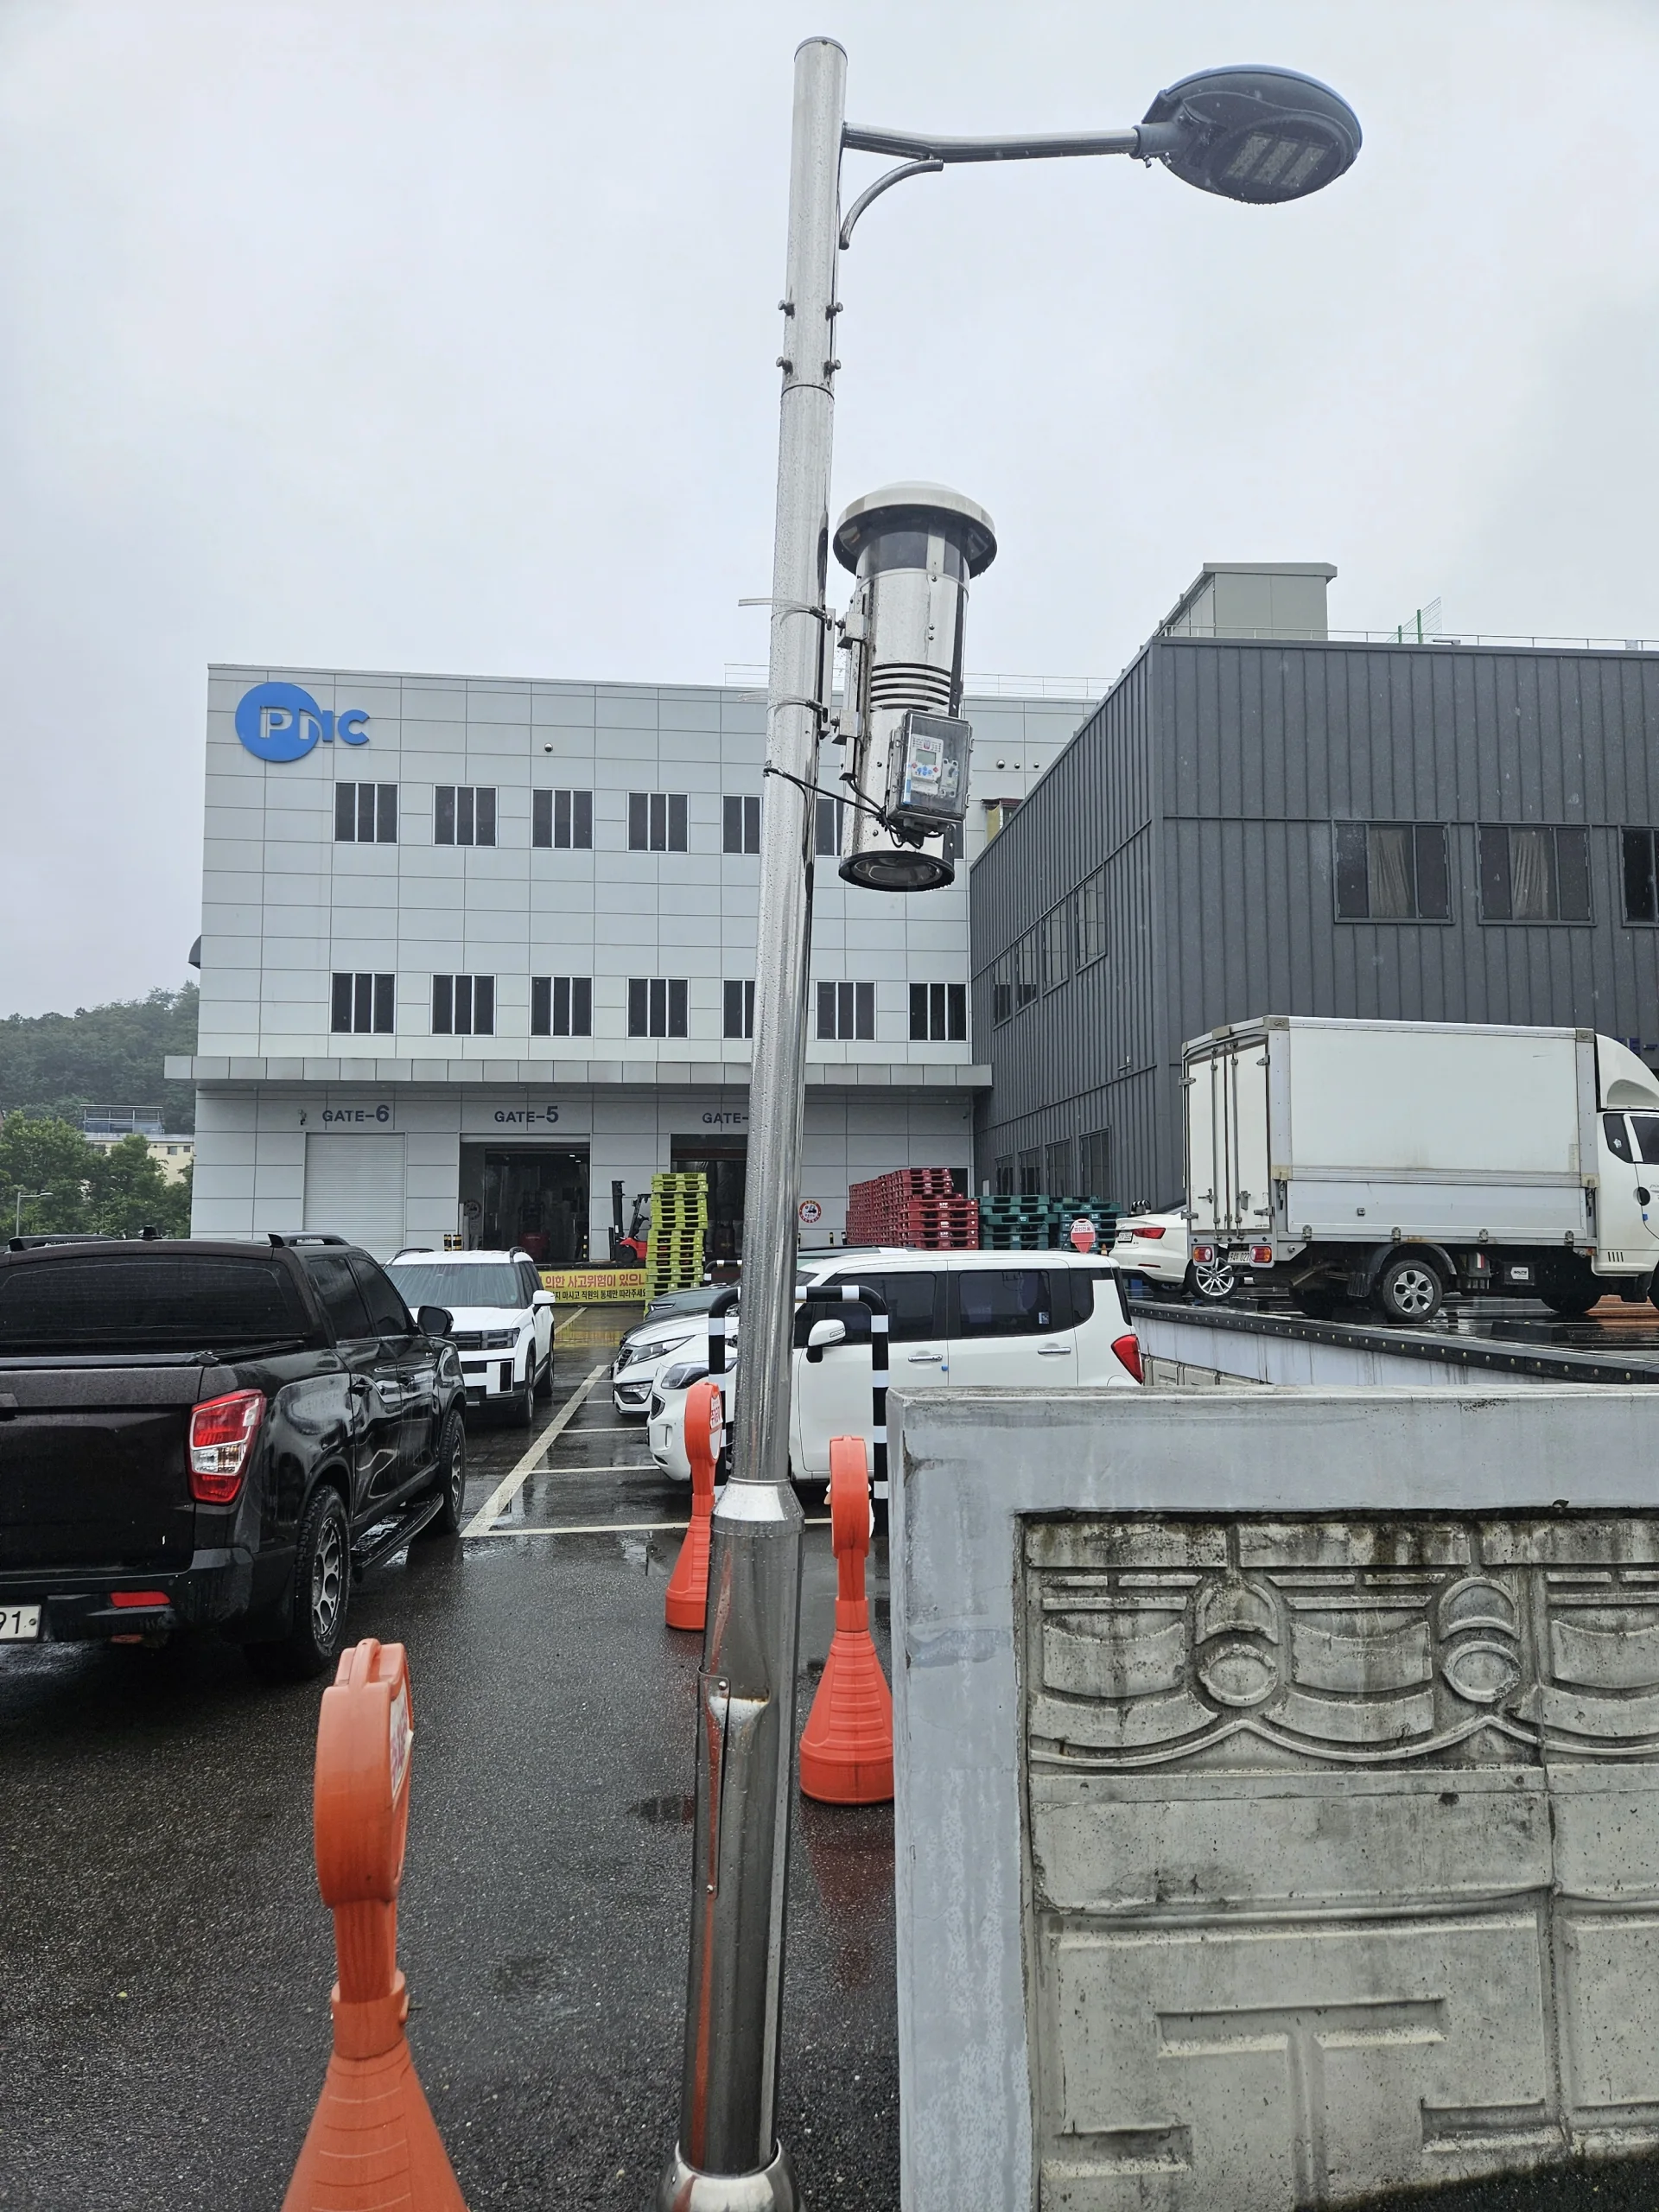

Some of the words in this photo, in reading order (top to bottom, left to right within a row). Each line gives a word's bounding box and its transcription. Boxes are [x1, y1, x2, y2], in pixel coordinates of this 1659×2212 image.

[322, 1104, 390, 1122] GATE-6
[494, 1105, 559, 1123] GATE-5
[702, 1112, 749, 1124] GATE-
[545, 1275, 565, 1288] 의한
[568, 1274, 616, 1287] 사고위험이
[563, 1290, 580, 1300] 마시고
[582, 1290, 599, 1300] 직원의
